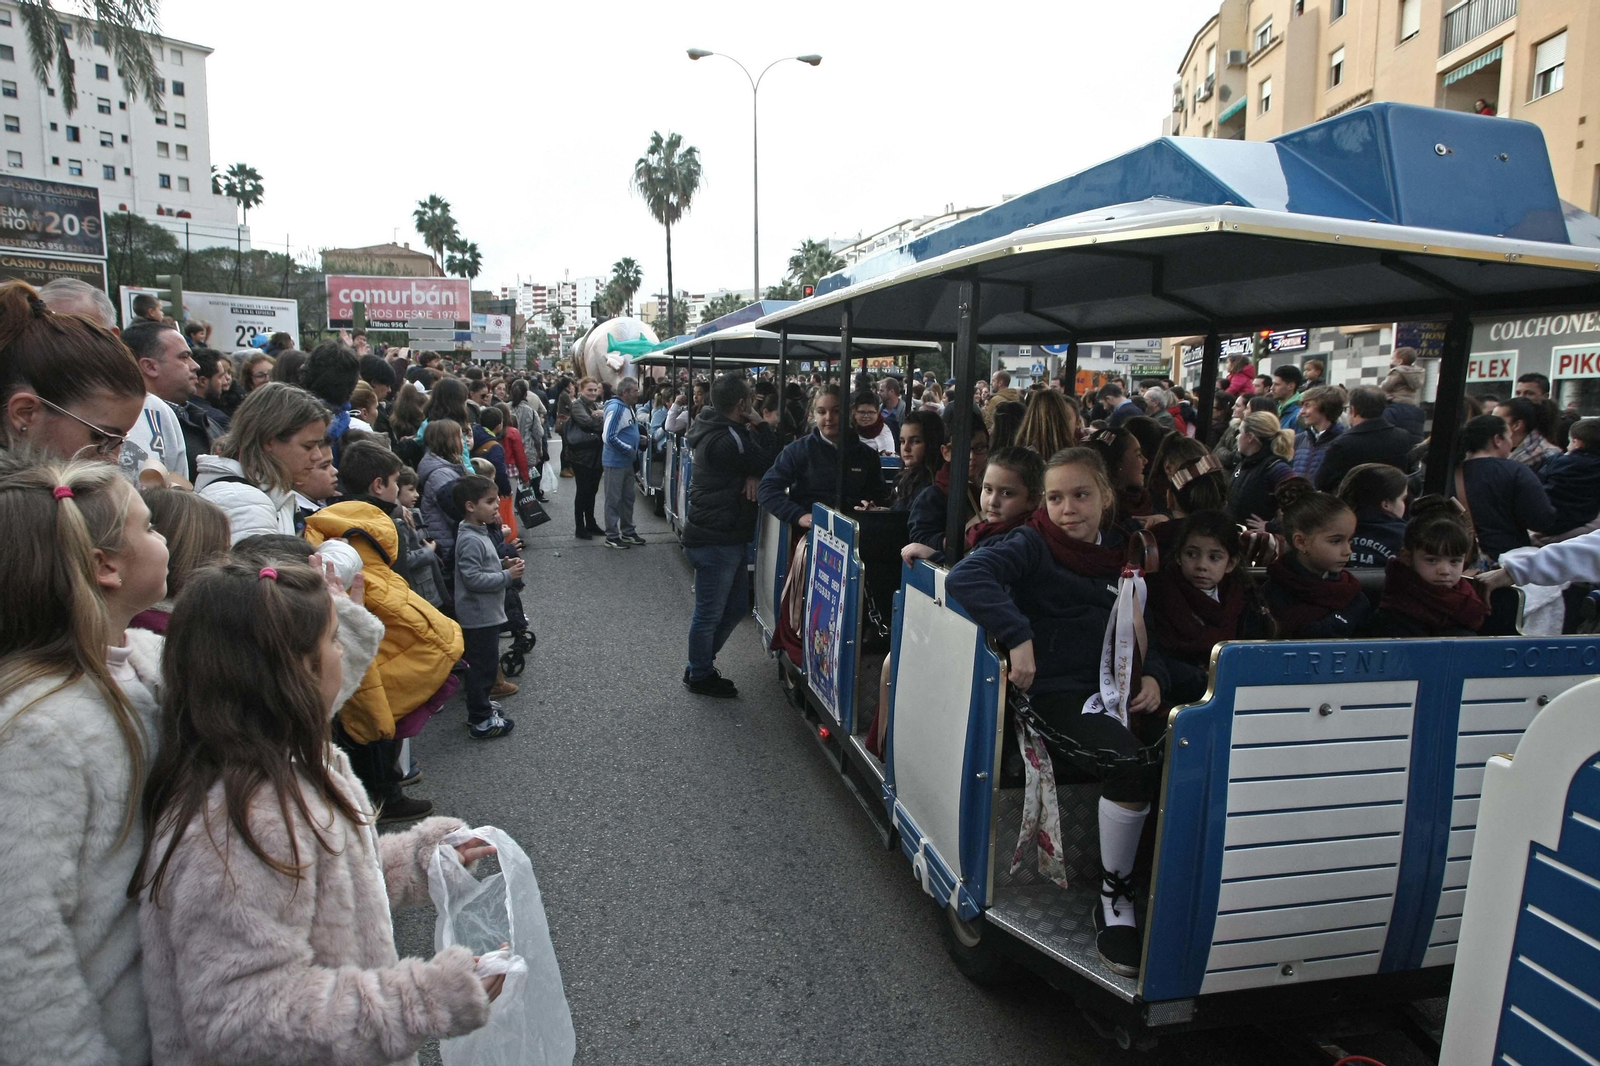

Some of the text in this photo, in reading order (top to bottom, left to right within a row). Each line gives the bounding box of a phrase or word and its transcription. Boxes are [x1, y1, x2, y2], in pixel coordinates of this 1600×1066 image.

[0, 177, 97, 200] CASINO ADMIRAL
[21, 193, 42, 203] SAN
[0, 206, 28, 219] ENA
[0, 217, 42, 233] HOW
[44, 211, 101, 238] 20€
[0, 238, 46, 250] RESERVAS
[1, 257, 101, 274] CASINO ADMIRAL
[24, 271, 44, 280] SAN
[338, 281, 454, 306] comurbán
[339, 308, 460, 319] CAEROS DESDE 1978
[1350, 552, 1374, 564] E LA
[1502, 644, 1598, 669] DOTTO
[1118, 656, 1128, 703] PREMIO
